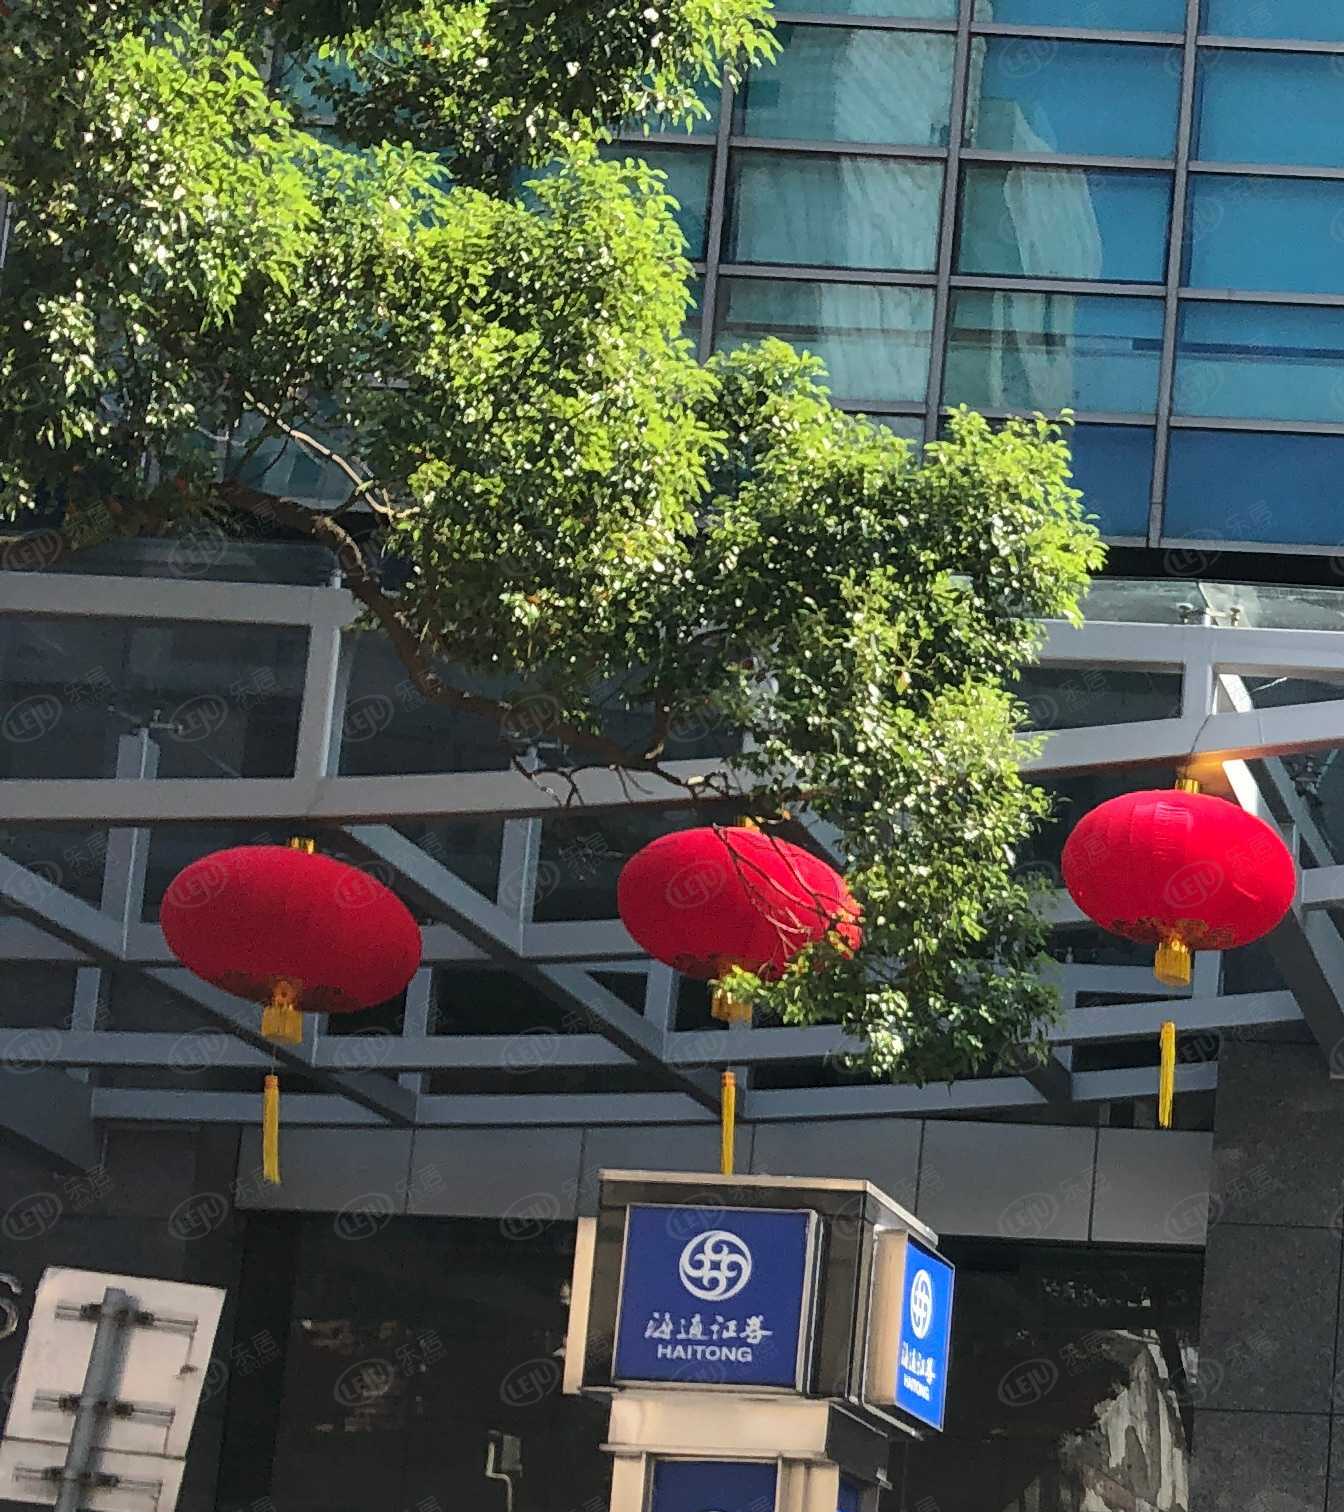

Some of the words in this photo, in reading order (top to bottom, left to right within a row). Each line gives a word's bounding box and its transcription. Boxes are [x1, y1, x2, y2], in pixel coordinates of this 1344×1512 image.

[645, 1312, 773, 1344] 海通证券
[657, 1344, 752, 1362] HAITONG
